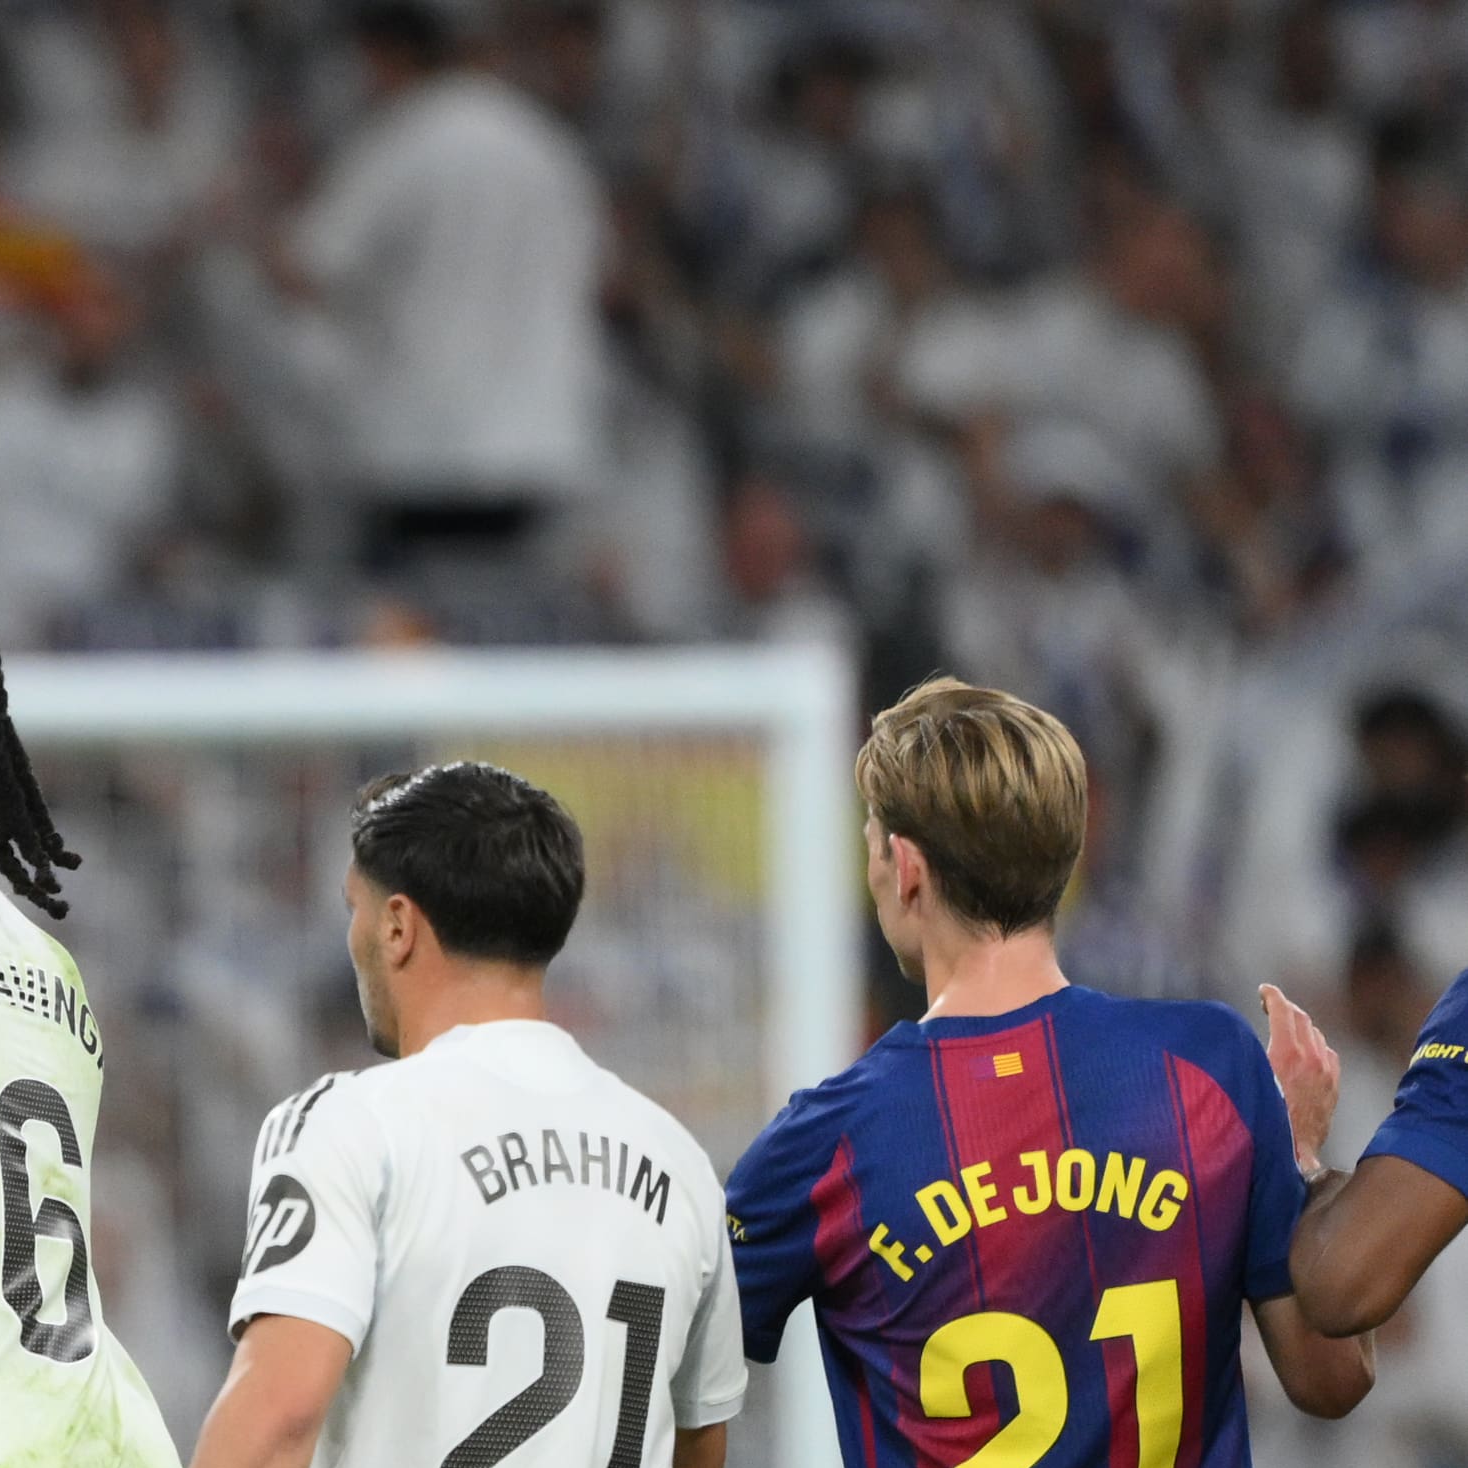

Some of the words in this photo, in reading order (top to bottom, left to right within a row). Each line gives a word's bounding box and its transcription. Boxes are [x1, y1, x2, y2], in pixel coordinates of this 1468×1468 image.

[460, 1129, 671, 1226] BRAHIM
[868, 1221, 934, 1283] F.
[915, 1160, 1008, 1247] DE
[1012, 1148, 1189, 1232] JONG
